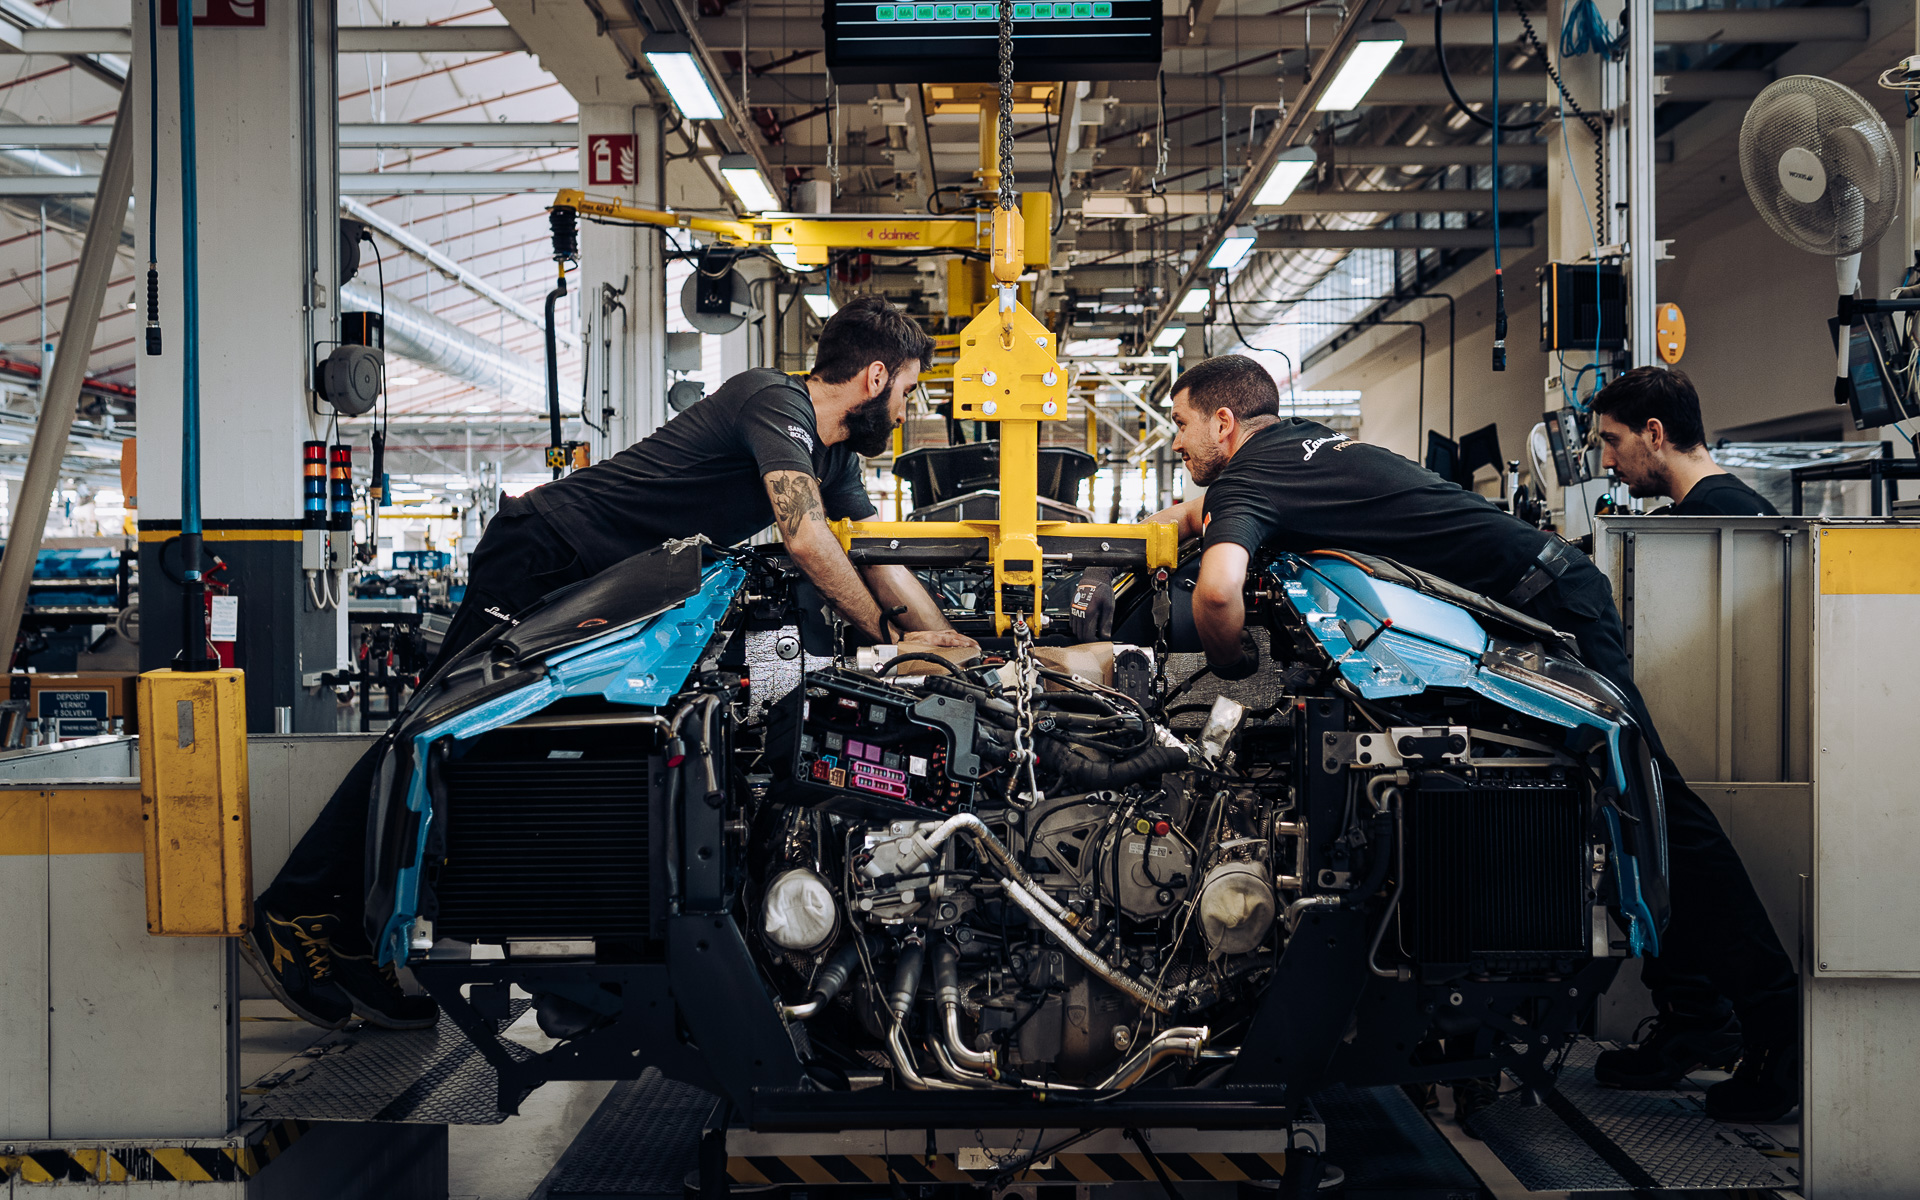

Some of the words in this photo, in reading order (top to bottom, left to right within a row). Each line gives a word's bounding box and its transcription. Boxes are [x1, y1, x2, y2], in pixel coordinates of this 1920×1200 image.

[878, 227, 920, 241] dalmec
[56, 693, 90, 701] DEPOSITO
[59, 701, 87, 709] VERNICI
[60, 709, 93, 717] SOLVENTI
